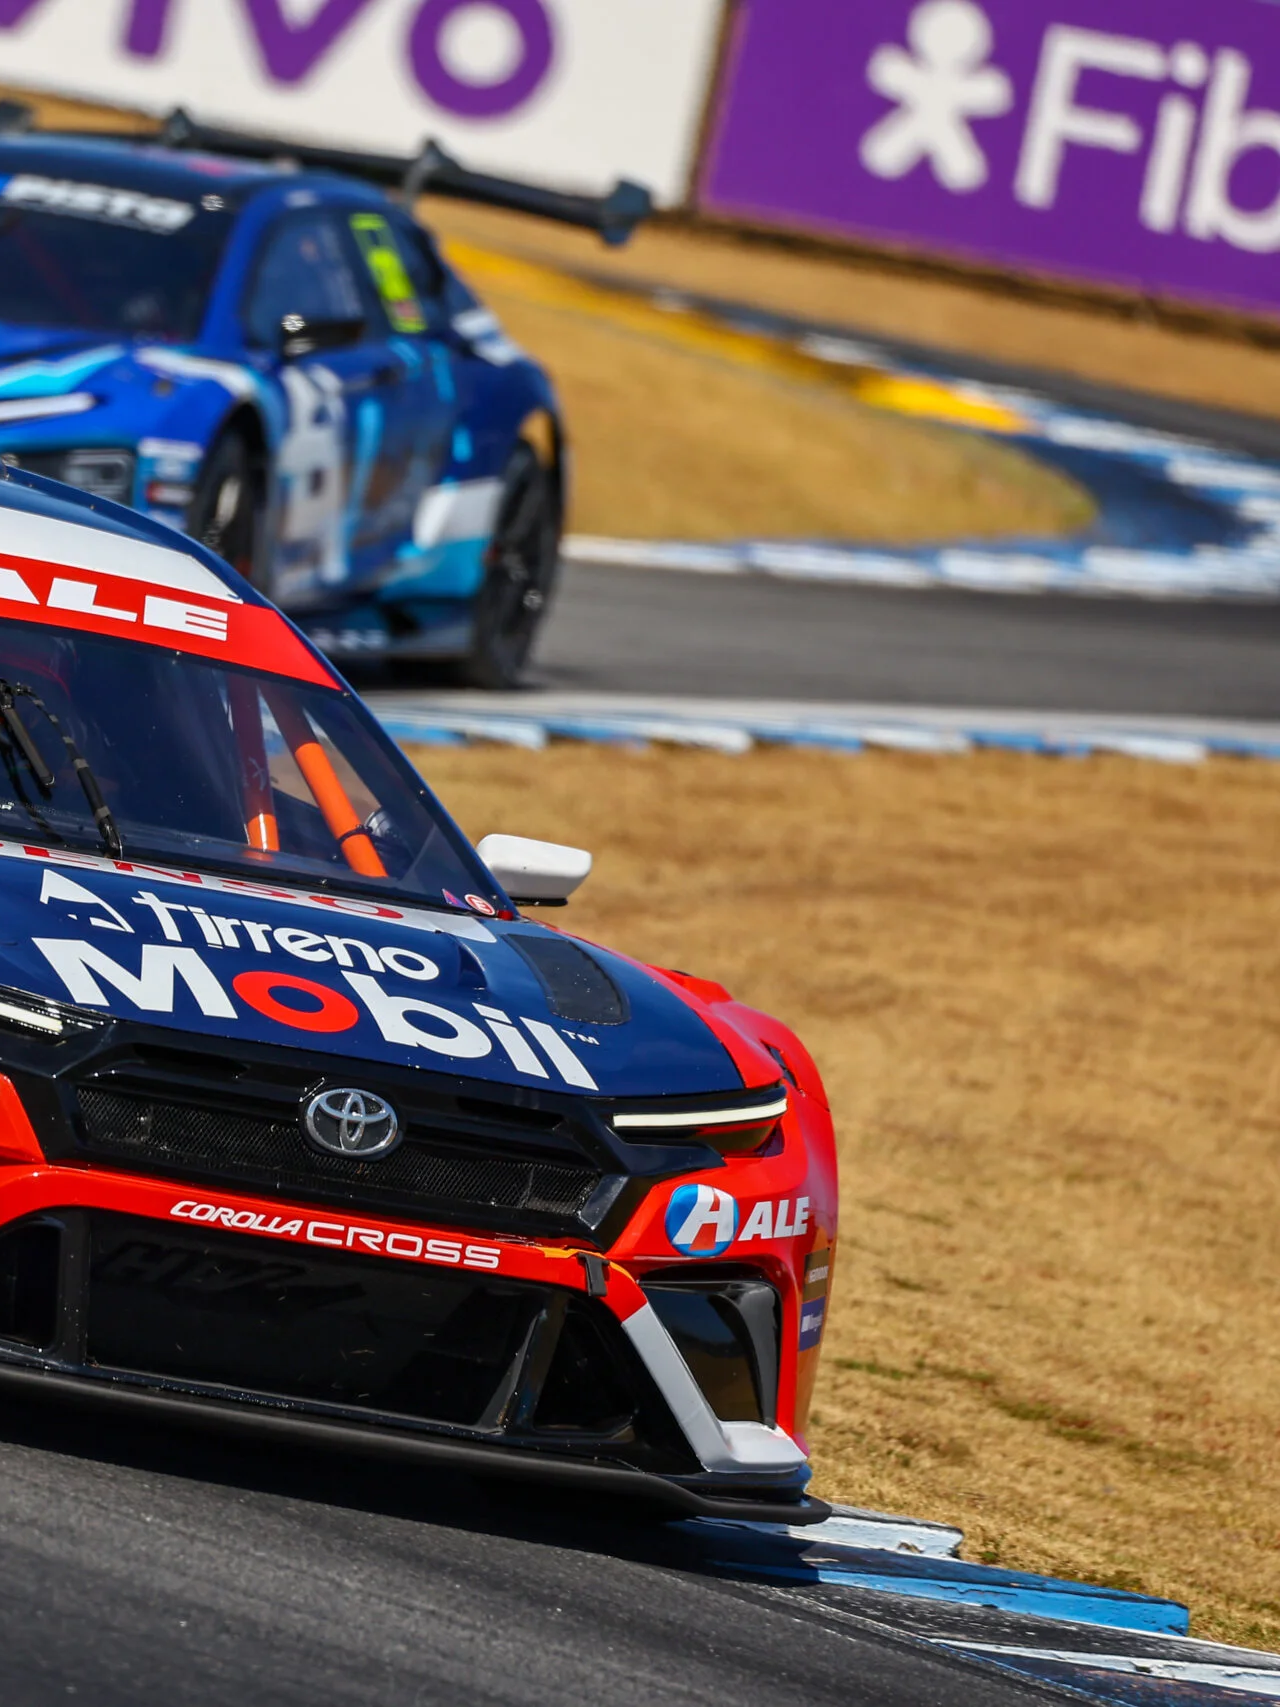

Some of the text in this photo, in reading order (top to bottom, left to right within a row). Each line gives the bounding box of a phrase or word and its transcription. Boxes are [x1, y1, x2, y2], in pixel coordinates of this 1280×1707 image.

[132, 890, 439, 981] tirreno
[30, 936, 599, 1091] Mobil
[170, 1200, 501, 1269] COROLLA CROSS
[738, 1196, 810, 1241] ALE
